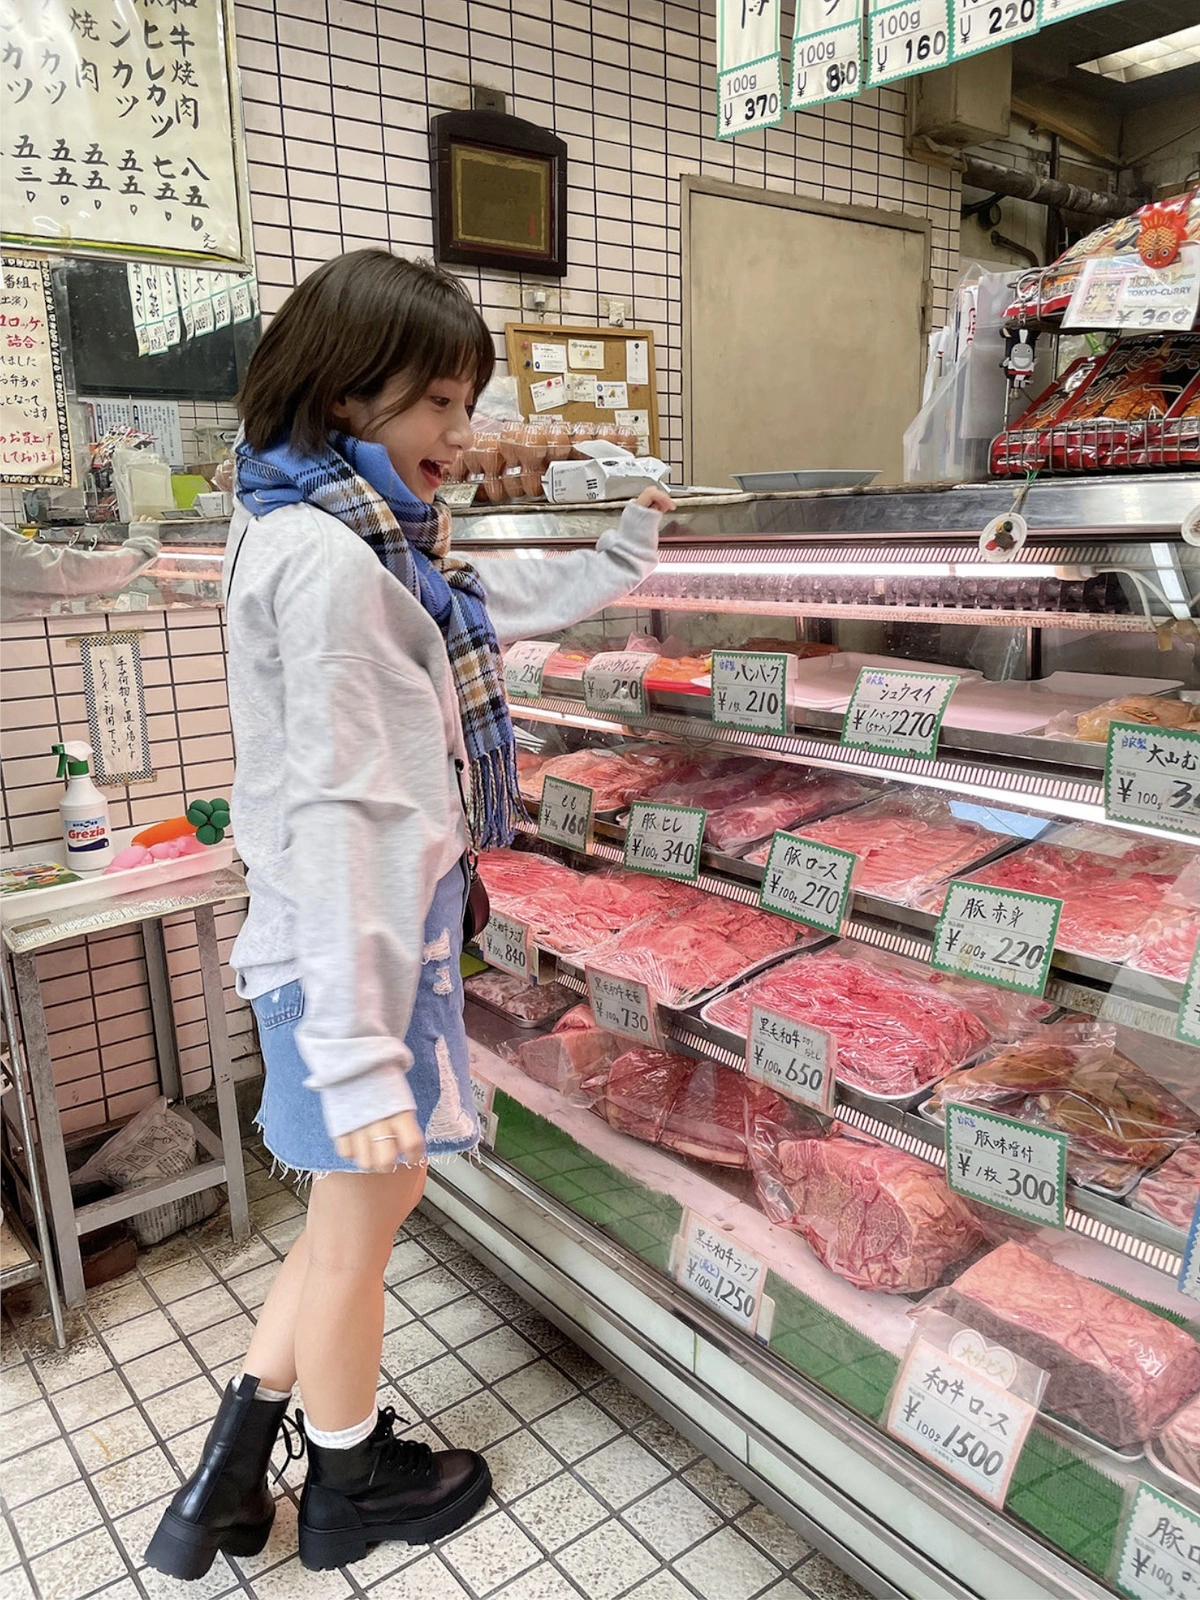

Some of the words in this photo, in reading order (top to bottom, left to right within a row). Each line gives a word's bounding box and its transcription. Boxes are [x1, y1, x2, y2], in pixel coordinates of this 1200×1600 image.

[878, 10, 920, 39] 100g
[989, 0, 1035, 34] 220
[69, 7, 100, 93] 焼肉
[799, 41, 836, 67] 100g
[905, 30, 946, 64] 160
[0, 22, 33, 104] カツ
[133, 0, 175, 138] ヒレカツ
[726, 74, 757, 96] 100g
[744, 93, 778, 120] 370
[1127, 286, 1192, 297] TOKYO-CURRY
[1139, 308, 1191, 326] 300
[23, 406, 48, 422] います
[519, 664, 541, 684] 250
[734, 662, 782, 684] ハンバーグ
[745, 690, 779, 714] 210
[880, 683, 936, 704] シュウマイ
[893, 709, 937, 738] 270
[1146, 743, 1199, 770] 大山む
[1138, 791, 1163, 809] 100g
[68, 826, 105, 839] Grezia
[561, 813, 586, 836] 160
[662, 839, 695, 864] 340
[800, 881, 840, 914] 270
[505, 944, 526, 967] 840
[992, 937, 1045, 970] 220
[621, 1007, 648, 1032] 730
[759, 1017, 801, 1049] 黒毛和牛
[785, 1058, 823, 1091] 650
[1005, 1168, 1056, 1206] 300
[942, 1424, 1004, 1477] 1500
